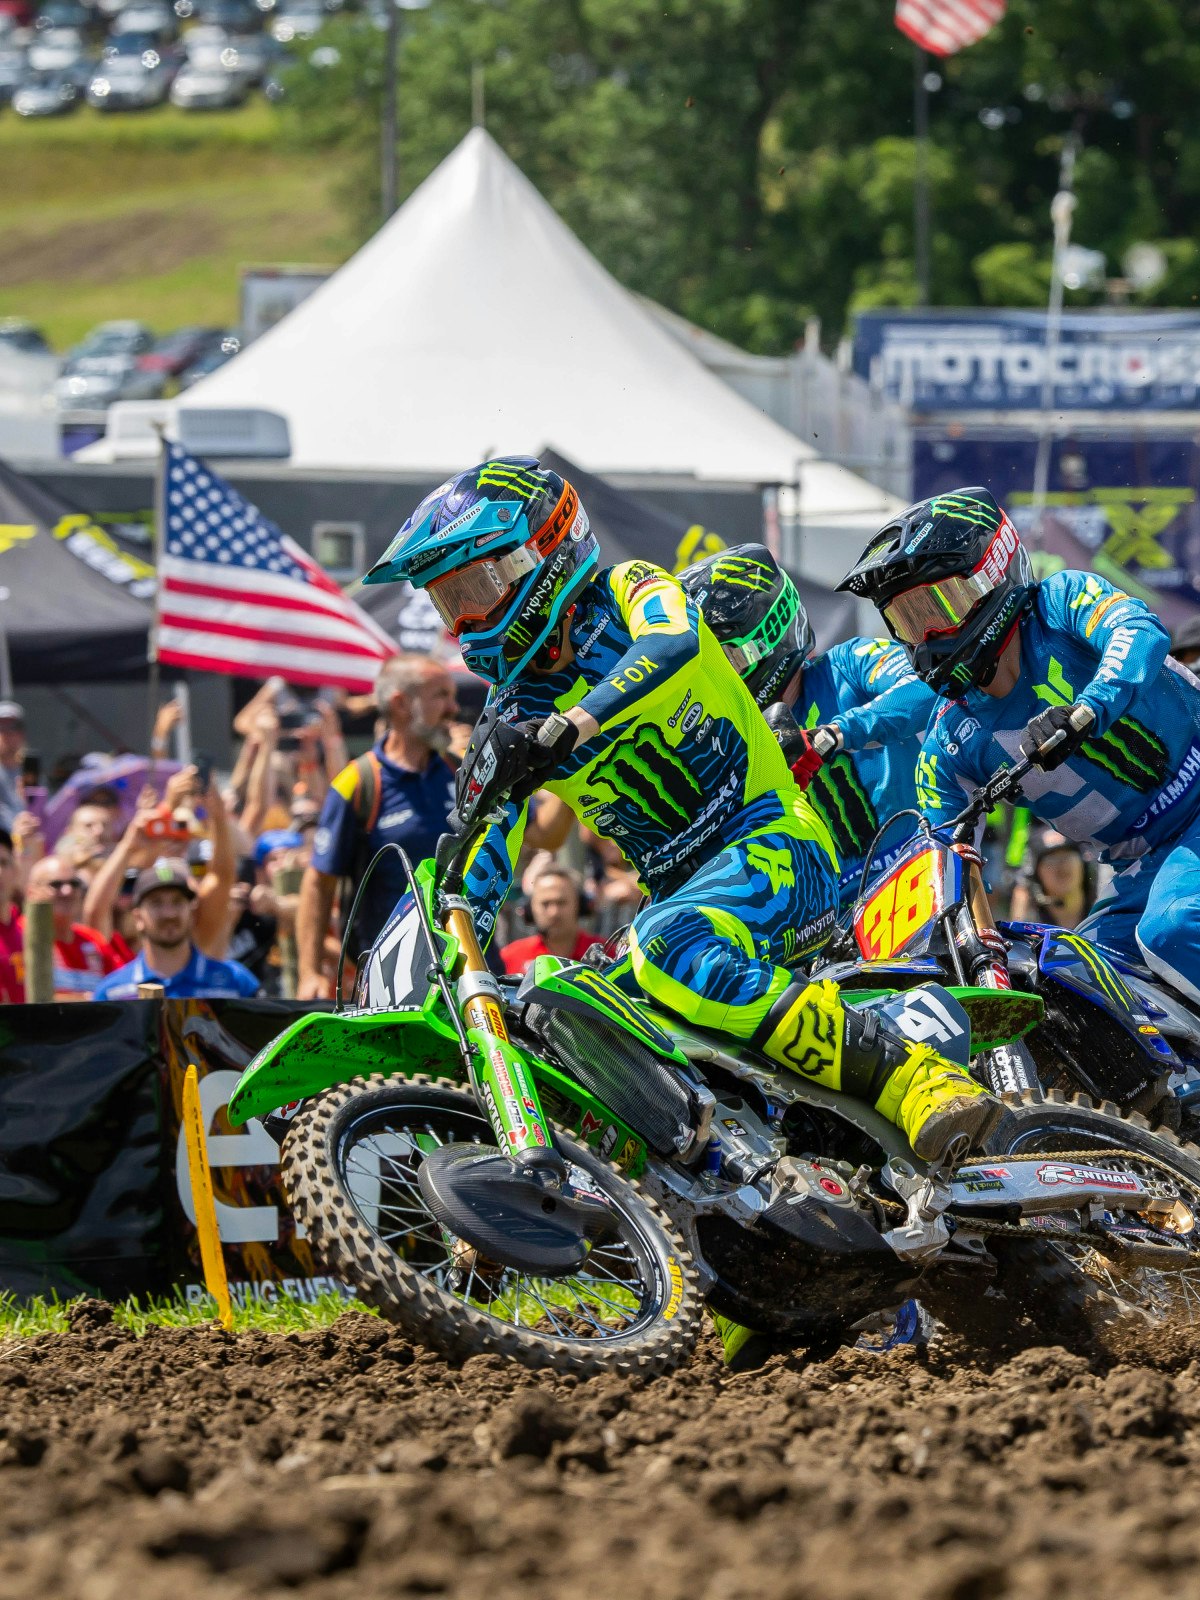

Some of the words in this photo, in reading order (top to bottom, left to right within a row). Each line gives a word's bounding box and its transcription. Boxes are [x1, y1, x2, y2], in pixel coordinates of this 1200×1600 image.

[438, 506, 482, 540] apdesigns
[905, 523, 933, 554] apdesigns
[521, 553, 567, 621] MONSTER
[576, 613, 612, 659] Kawasaki
[980, 592, 1016, 647] MONSTER
[610, 655, 659, 694] FOX
[755, 655, 791, 706] MONSTER
[684, 707, 701, 730] BELL
[990, 776, 1012, 799] ARC
[583, 802, 610, 818] DUNLOP
[648, 859, 673, 878] PRO
[864, 849, 939, 959] 38
[795, 909, 836, 944] MONSTER
[896, 988, 965, 1044] 47
[492, 1049, 515, 1098] BRAKING
[1014, 1054, 1030, 1090] BRAKING
[665, 1263, 683, 1320] DUNLOP
